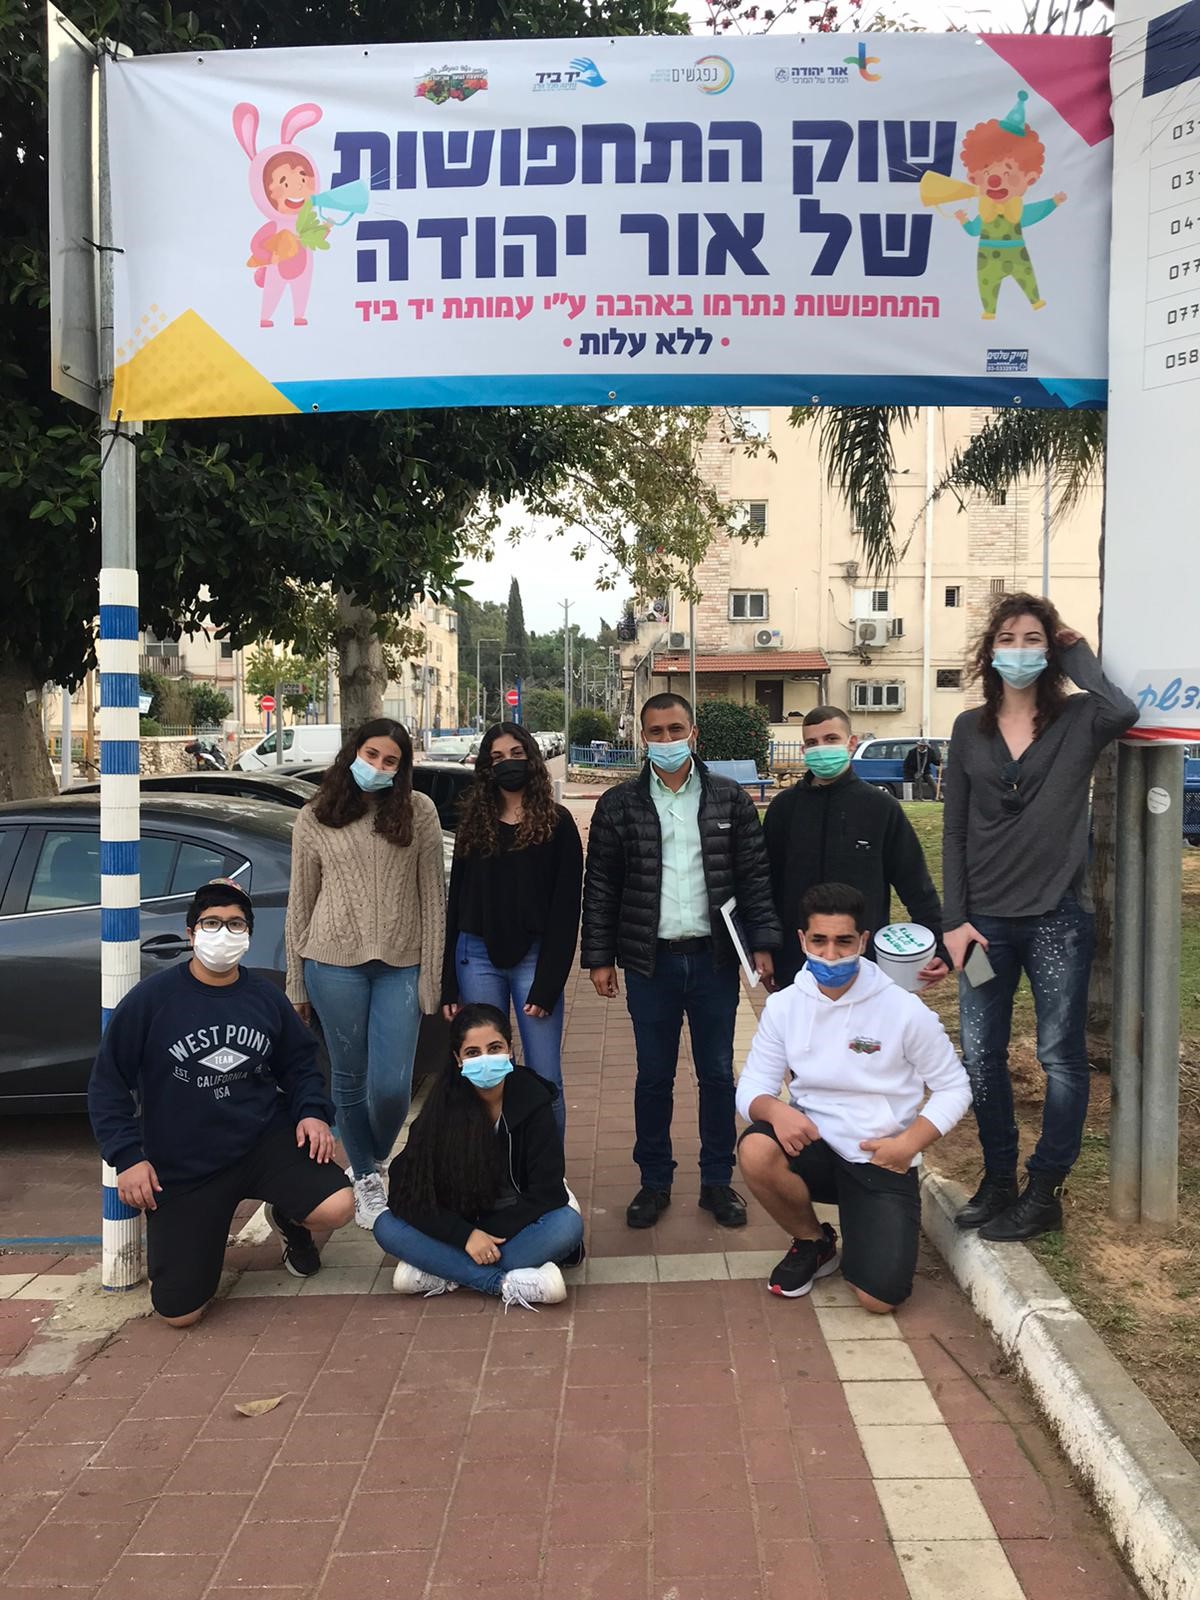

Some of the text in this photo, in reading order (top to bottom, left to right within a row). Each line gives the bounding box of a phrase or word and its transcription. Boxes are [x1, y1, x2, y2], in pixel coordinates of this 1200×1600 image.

[535, 71, 581, 83] יד ביד
[672, 67, 718, 82] נפגשים
[791, 66, 848, 76] אור יהודה
[330, 119, 957, 196] שוק התחפושות
[355, 197, 934, 283] של אור יהודה
[354, 299, 398, 322] ביד
[407, 298, 434, 320] יד
[441, 295, 534, 321] עמותת
[596, 293, 694, 317] באהבה
[703, 294, 786, 317] נתרמו
[794, 294, 940, 318] התחפושות
[578, 327, 713, 358] ללא עלות
[1165, 349, 1199, 369] 058
[168, 1024, 271, 1062] WEST POINT
[214, 1055, 234, 1065] TEAM
[196, 1071, 248, 1088] CALIFORNIA
[213, 1086, 231, 1100] USA
